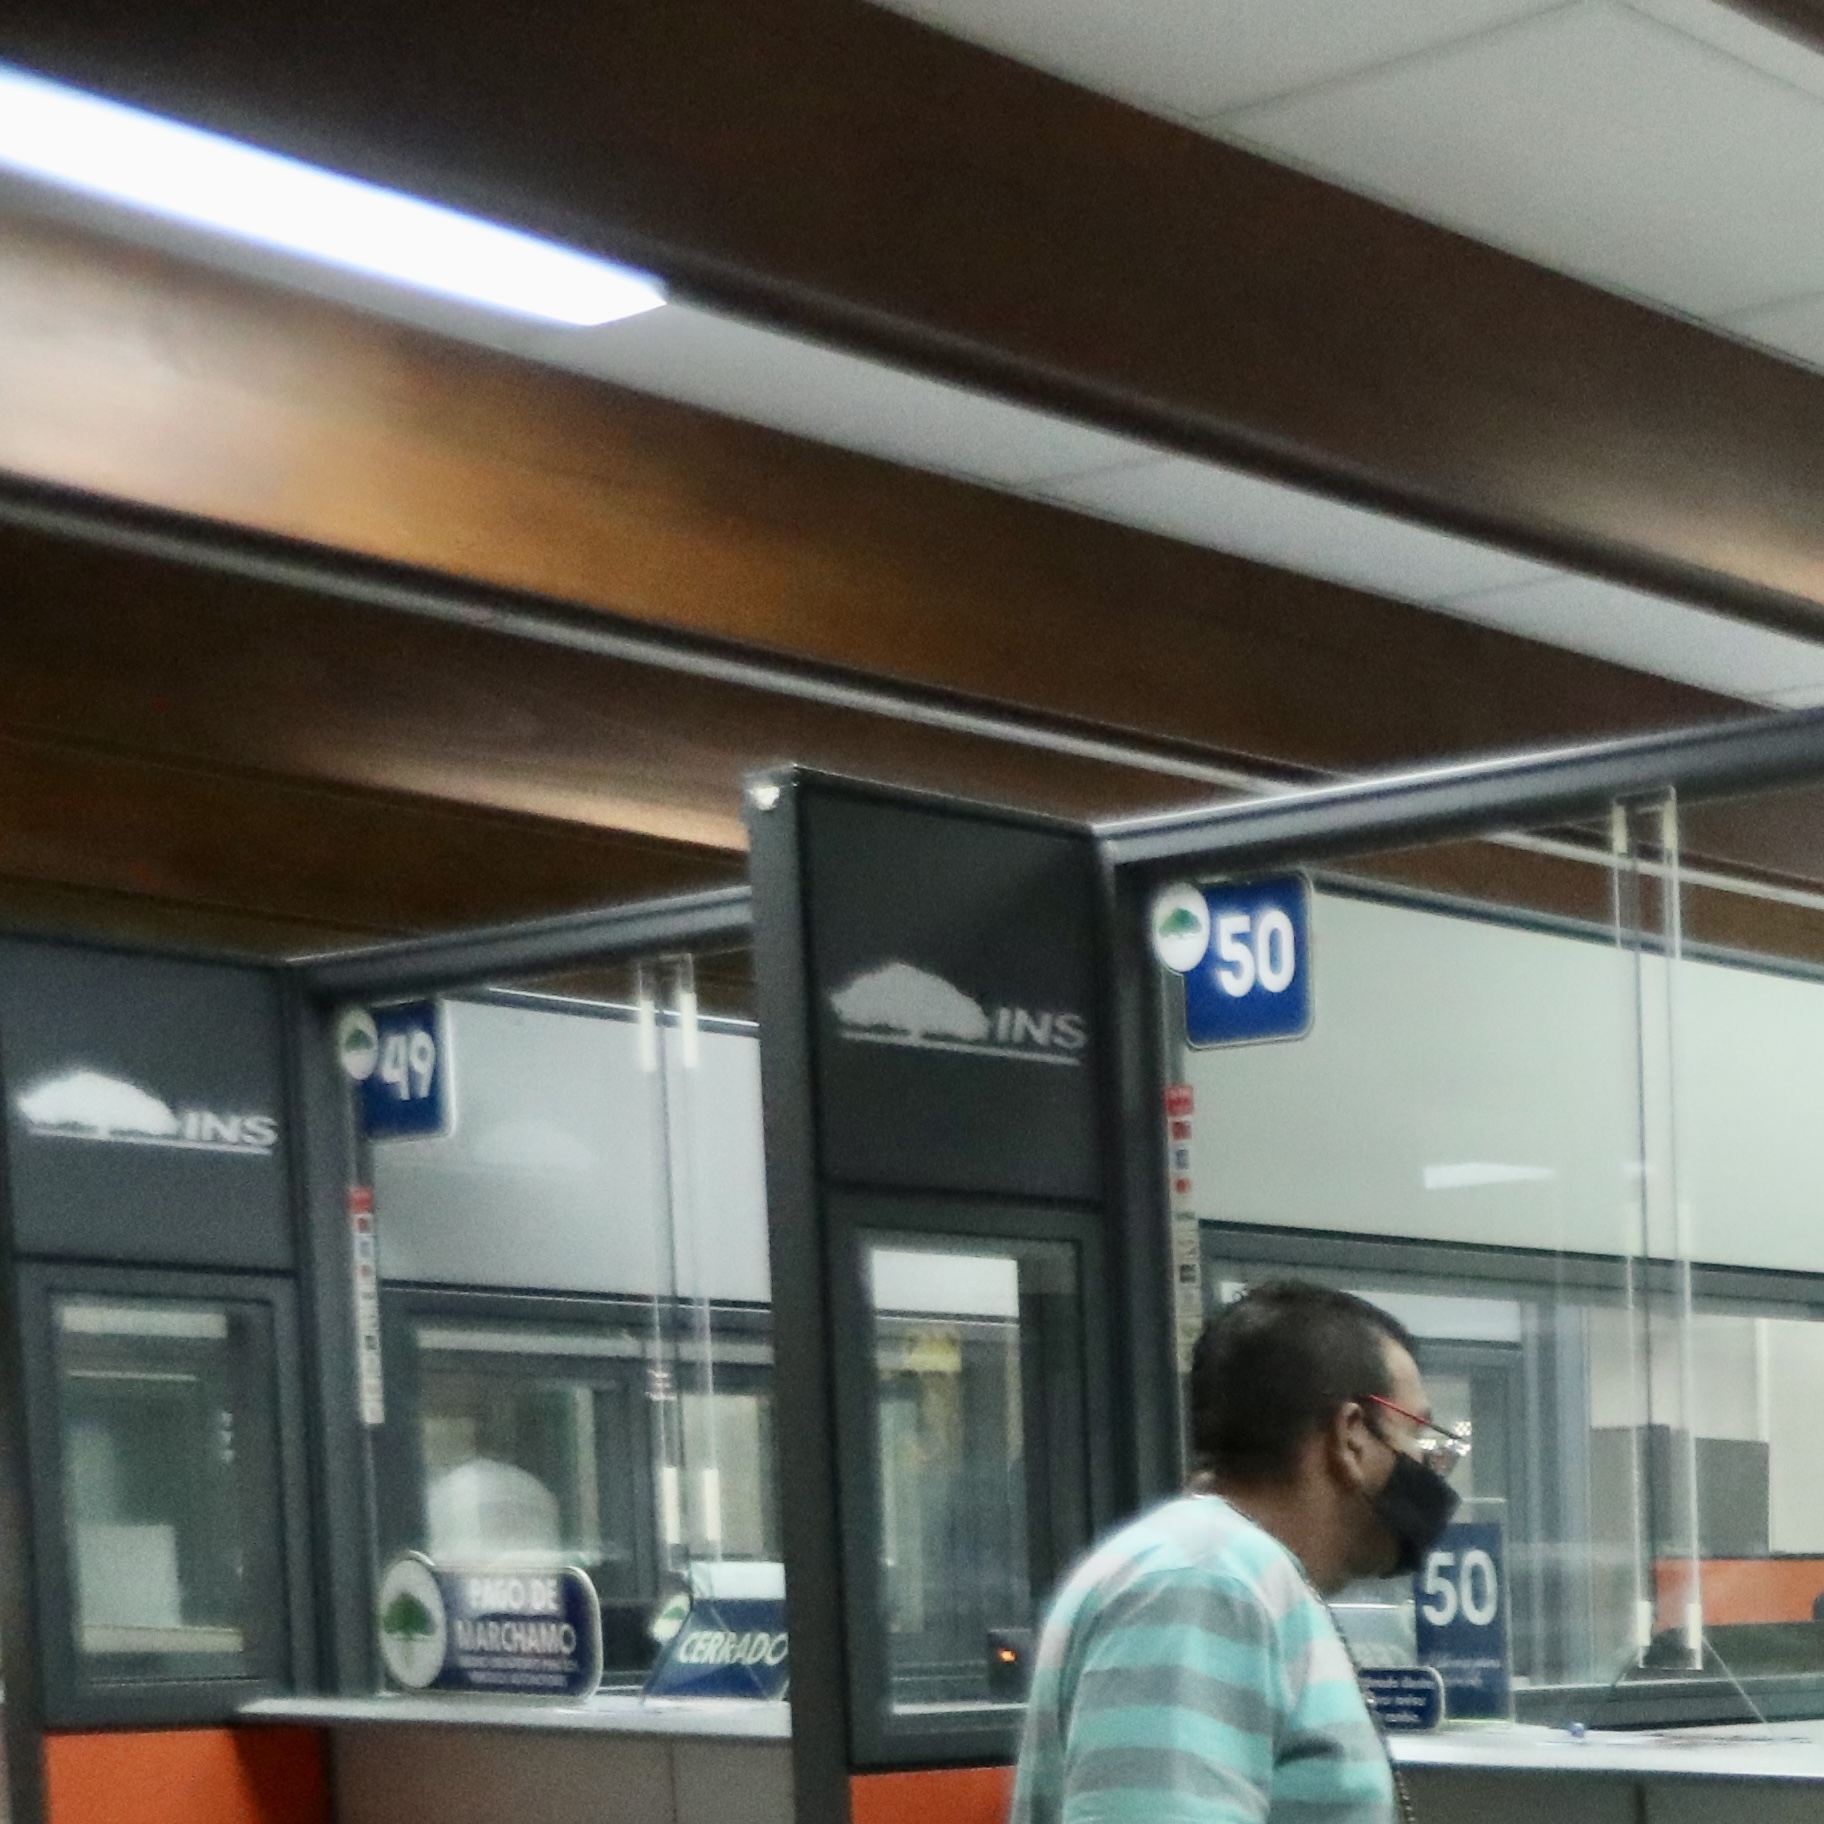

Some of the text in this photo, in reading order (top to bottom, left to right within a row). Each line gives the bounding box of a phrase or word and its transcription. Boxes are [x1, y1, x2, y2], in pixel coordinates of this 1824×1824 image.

[1216, 908, 1296, 997] 50
[998, 1006, 1089, 1050] INS
[379, 1027, 437, 1101] 49
[182, 1110, 279, 1147] INS
[1422, 1548, 1498, 1627] 50
[456, 1619, 577, 1656] MARCHAMO
[678, 1630, 789, 1667] CERRADO
